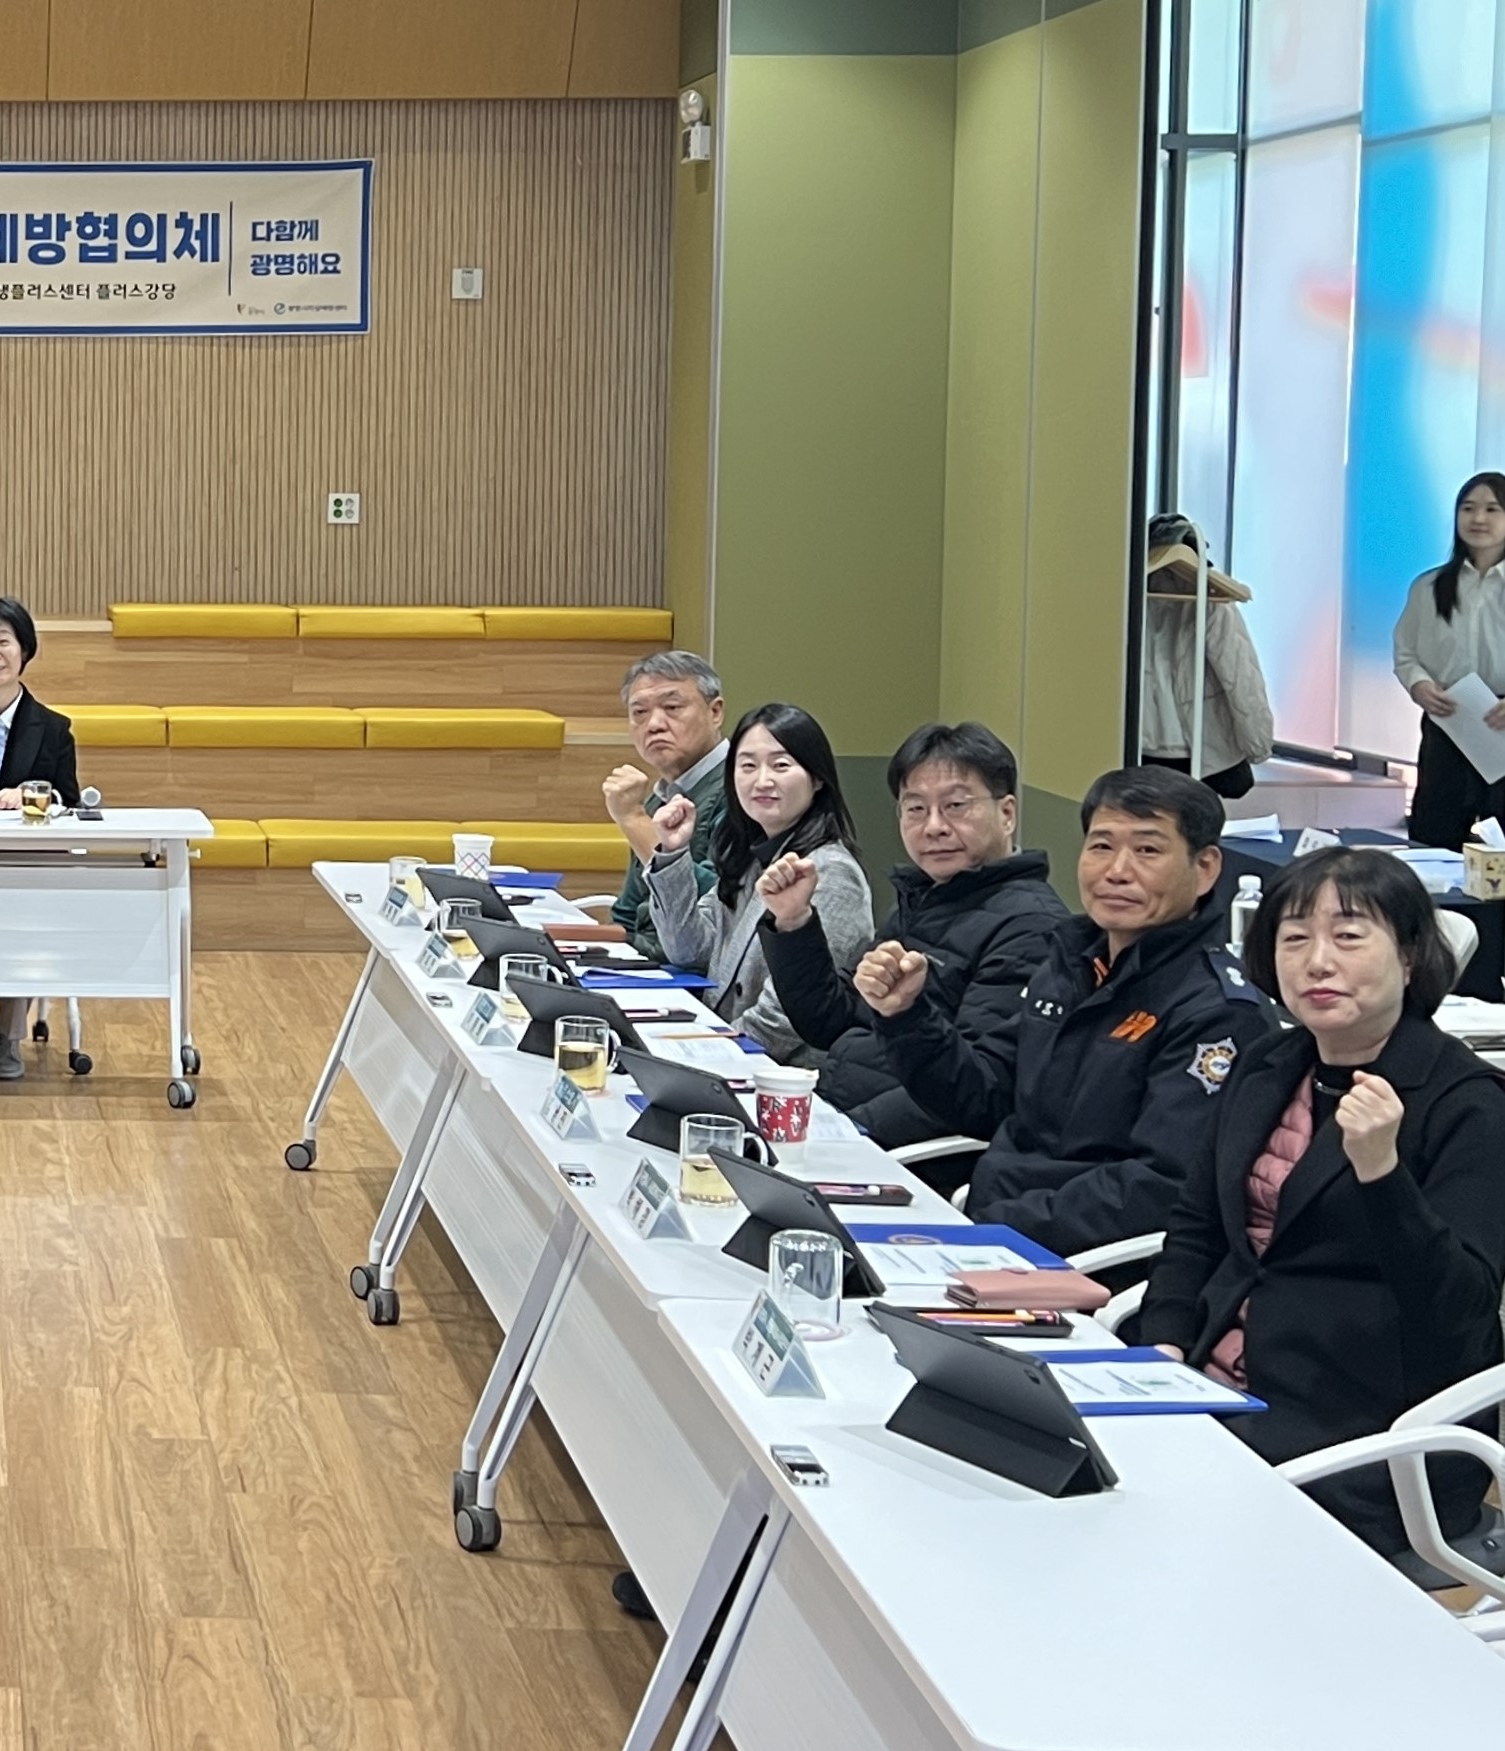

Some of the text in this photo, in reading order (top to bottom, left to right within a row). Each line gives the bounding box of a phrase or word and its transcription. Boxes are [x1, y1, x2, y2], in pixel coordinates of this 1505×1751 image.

[251, 218, 320, 243] 다함께
[249, 252, 342, 277] 광명해요
[95, 283, 177, 301] 플러스강당
